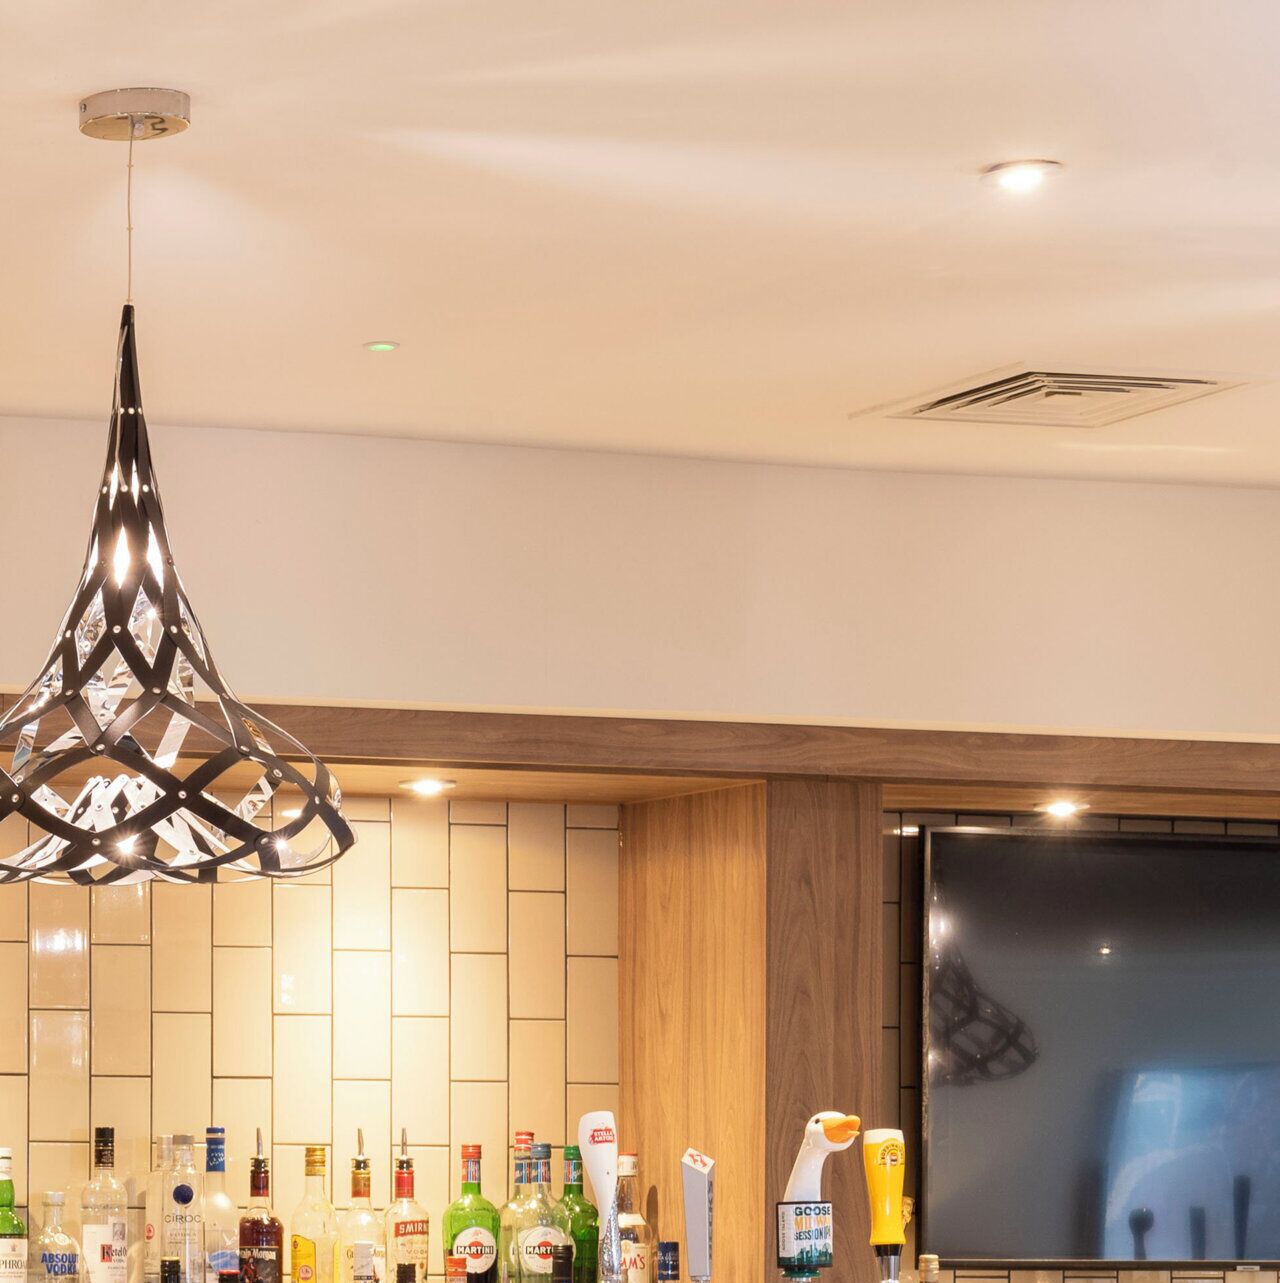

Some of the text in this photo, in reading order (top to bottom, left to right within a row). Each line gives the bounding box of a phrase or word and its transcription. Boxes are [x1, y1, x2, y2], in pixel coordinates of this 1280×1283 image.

[794, 1206, 831, 1216] GOOSE
[253, 1247, 277, 1260] Morgan
[456, 1245, 494, 1255] MARTINI
